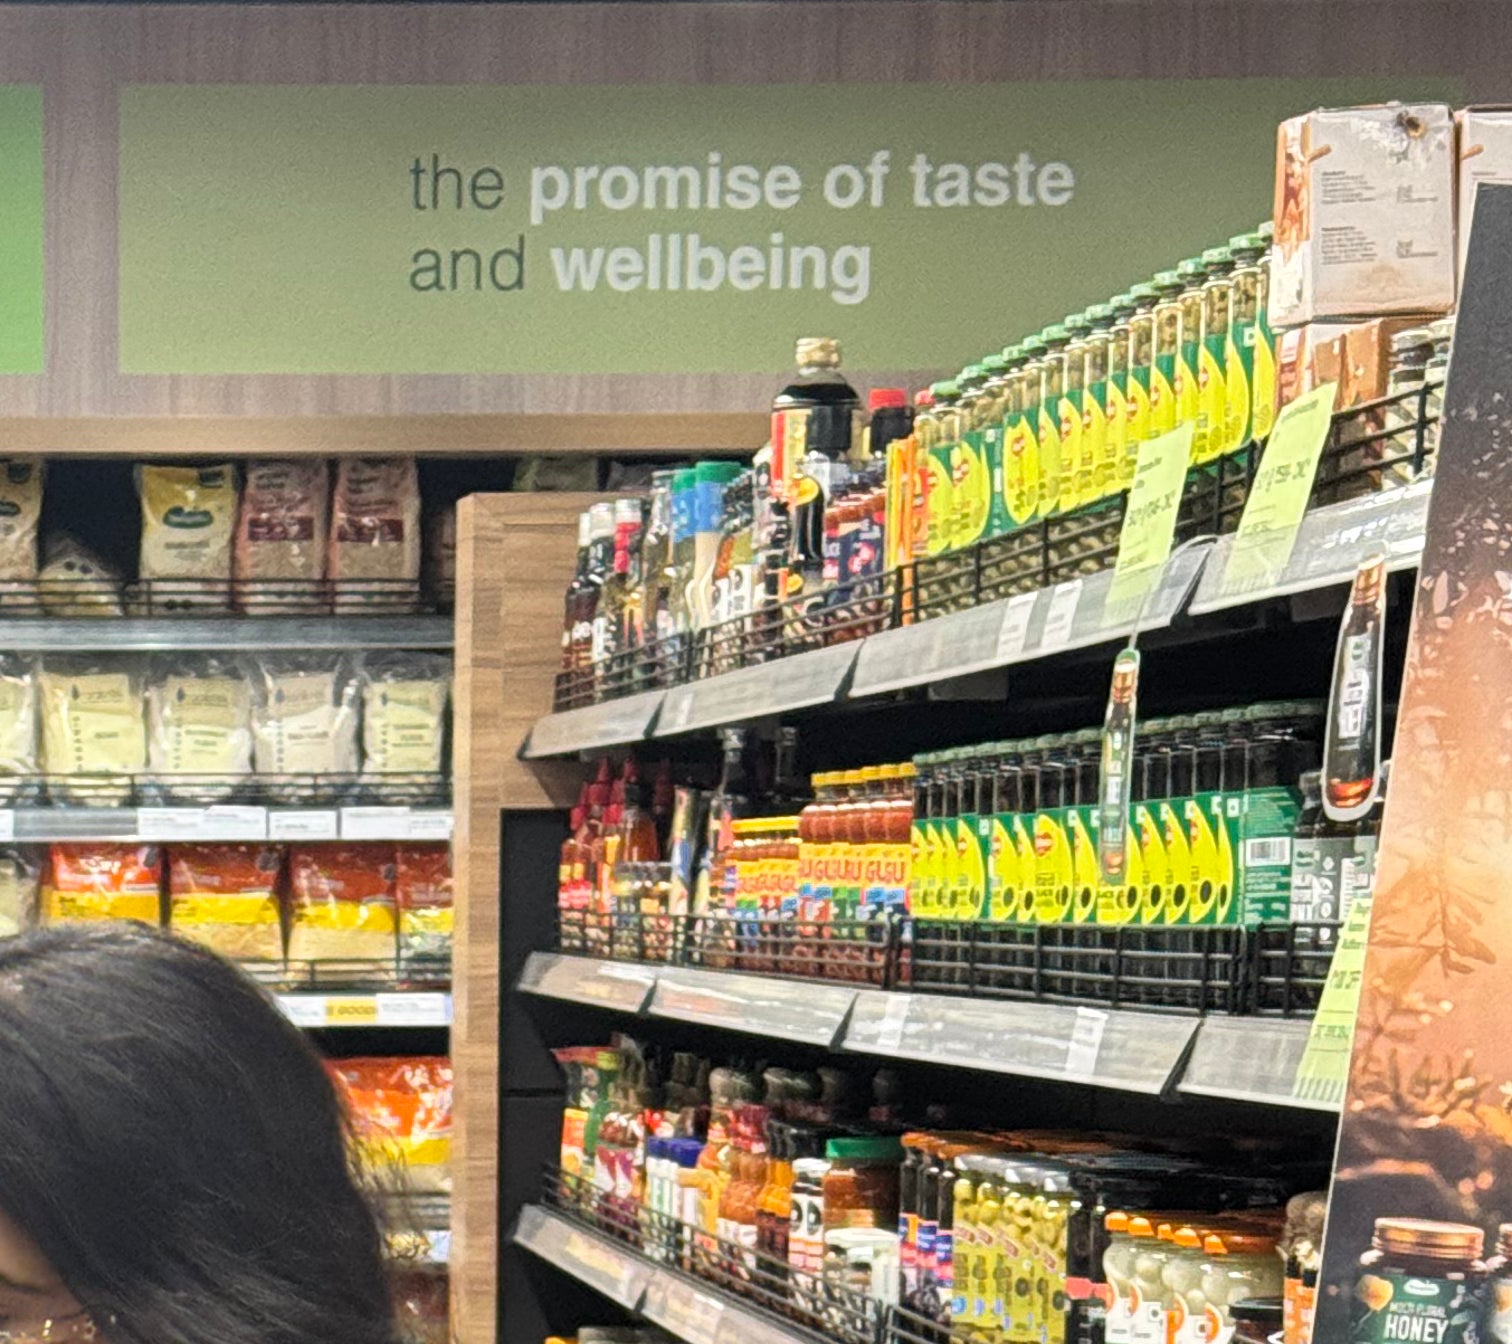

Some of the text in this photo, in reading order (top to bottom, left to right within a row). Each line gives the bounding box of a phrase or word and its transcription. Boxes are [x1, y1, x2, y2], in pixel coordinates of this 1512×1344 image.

[410, 150, 1075, 225] the promise of taste
[409, 231, 871, 305] and wellbeing
[1383, 1313, 1449, 1344] HONEY
